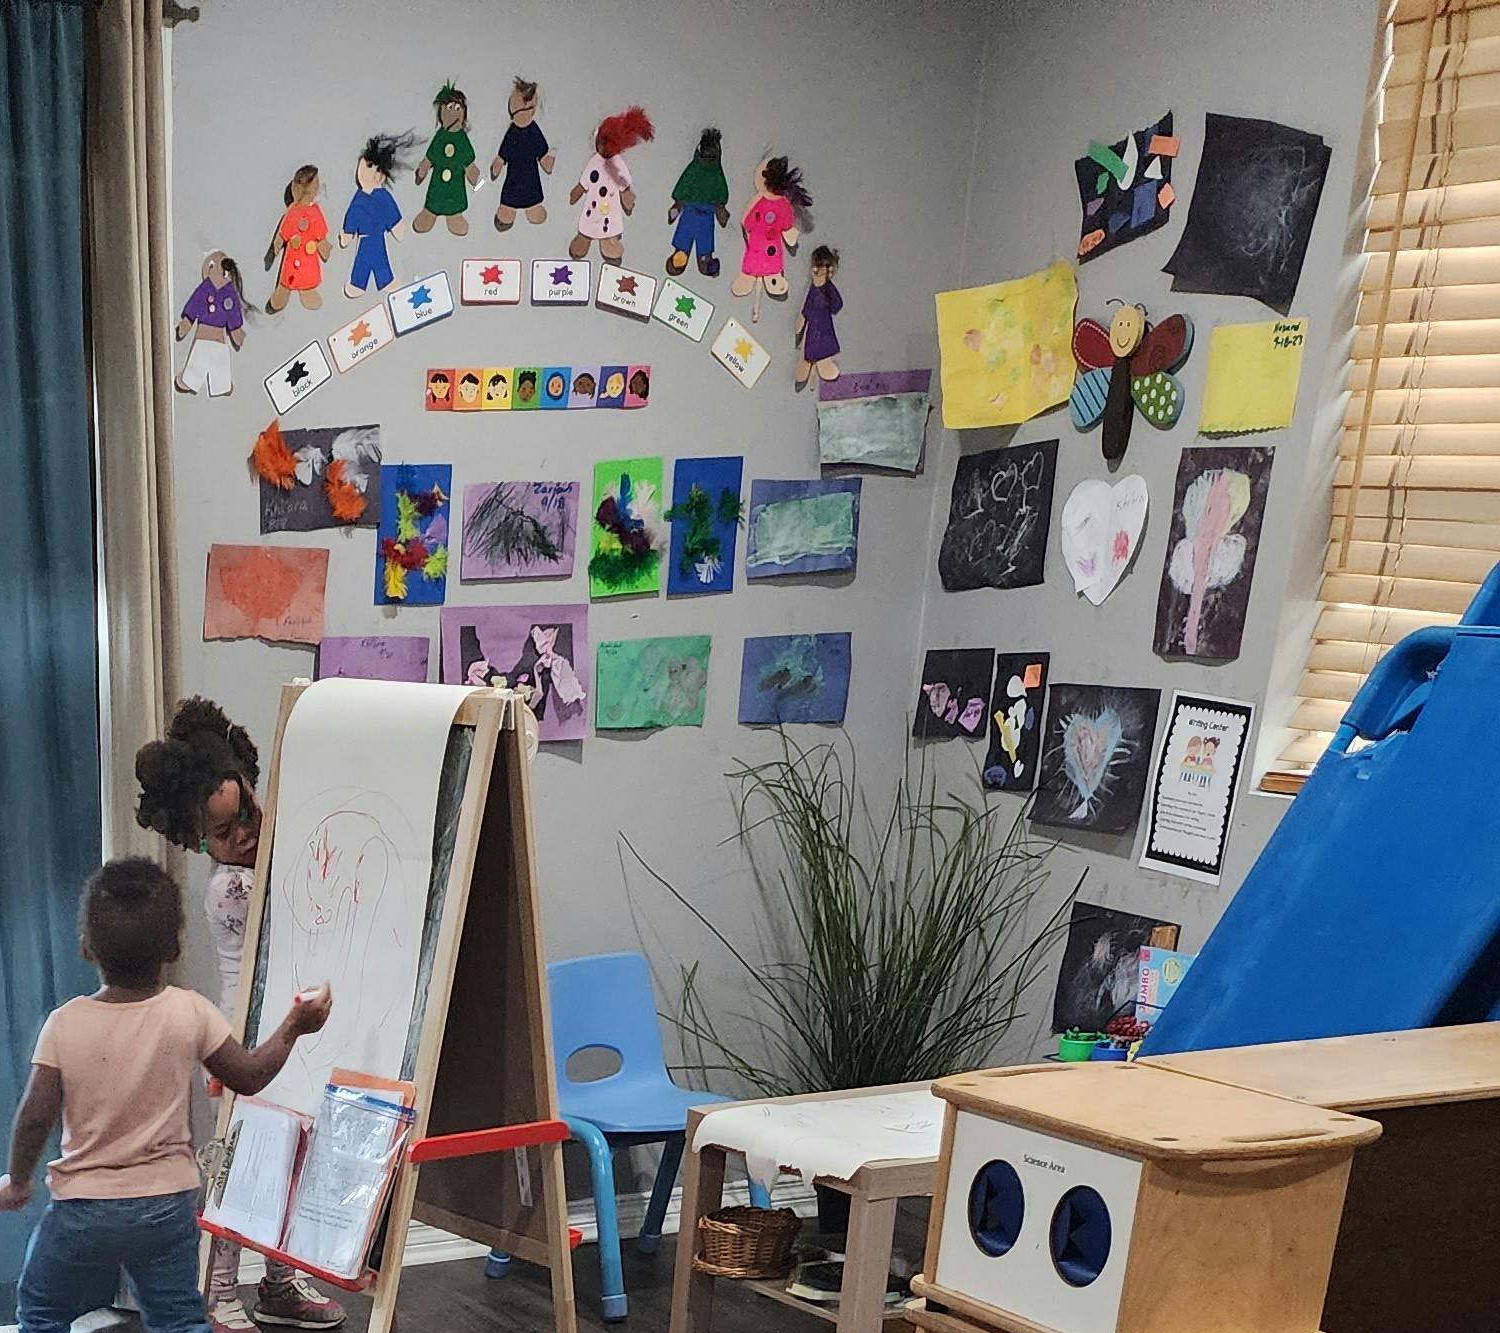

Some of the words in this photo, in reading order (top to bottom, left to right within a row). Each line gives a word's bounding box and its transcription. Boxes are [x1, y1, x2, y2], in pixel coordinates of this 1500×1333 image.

[484, 287, 498, 296] red
[548, 288, 573, 297] purple
[612, 294, 636, 307] brown
[414, 306, 433, 319] blue
[668, 312, 689, 329] green
[351, 338, 378, 360] orange
[724, 351, 745, 374] yellow
[292, 378, 313, 397] black
[1023, 1153, 1048, 1169] Science
[1049, 1161, 1066, 1174] Area
